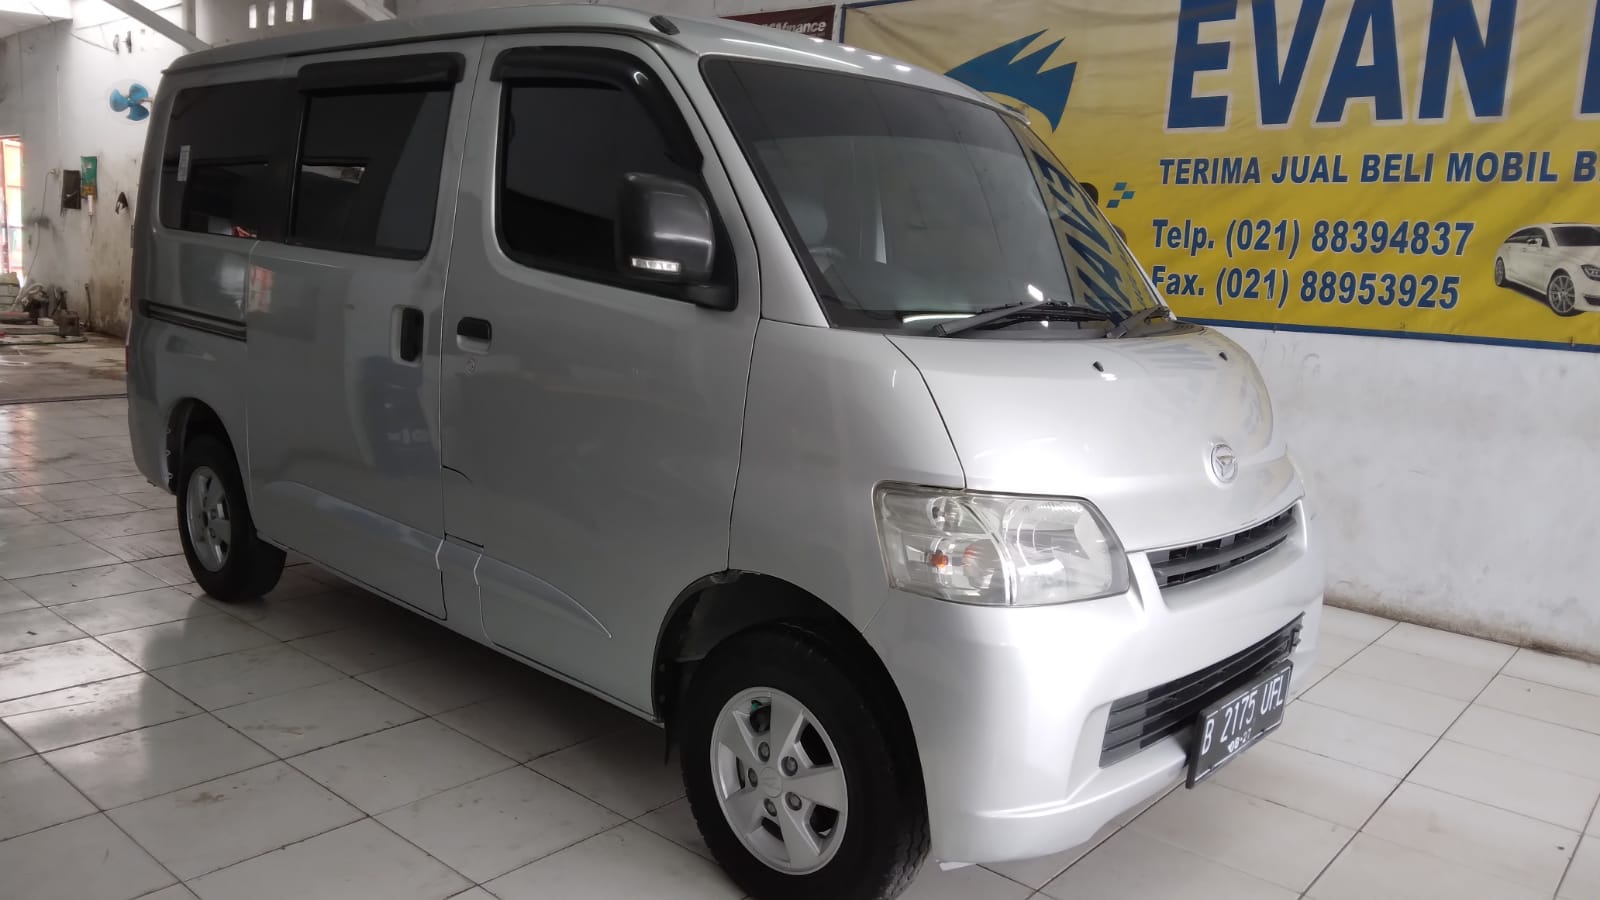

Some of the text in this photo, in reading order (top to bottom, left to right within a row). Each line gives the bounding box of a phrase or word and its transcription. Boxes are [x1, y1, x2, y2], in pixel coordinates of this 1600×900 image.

[1166, 0, 1518, 130] EVAN
[1159, 150, 1600, 185] TERIMA JUAL BELI MOBIL B
[1152, 219, 1475, 260] Telp. (021) 88394837
[1152, 265, 1205, 296] Fax.
[1216, 267, 1289, 309] (021)
[1300, 270, 1460, 310] 88953925
[1201, 674, 1285, 756] B 2175 UFL
